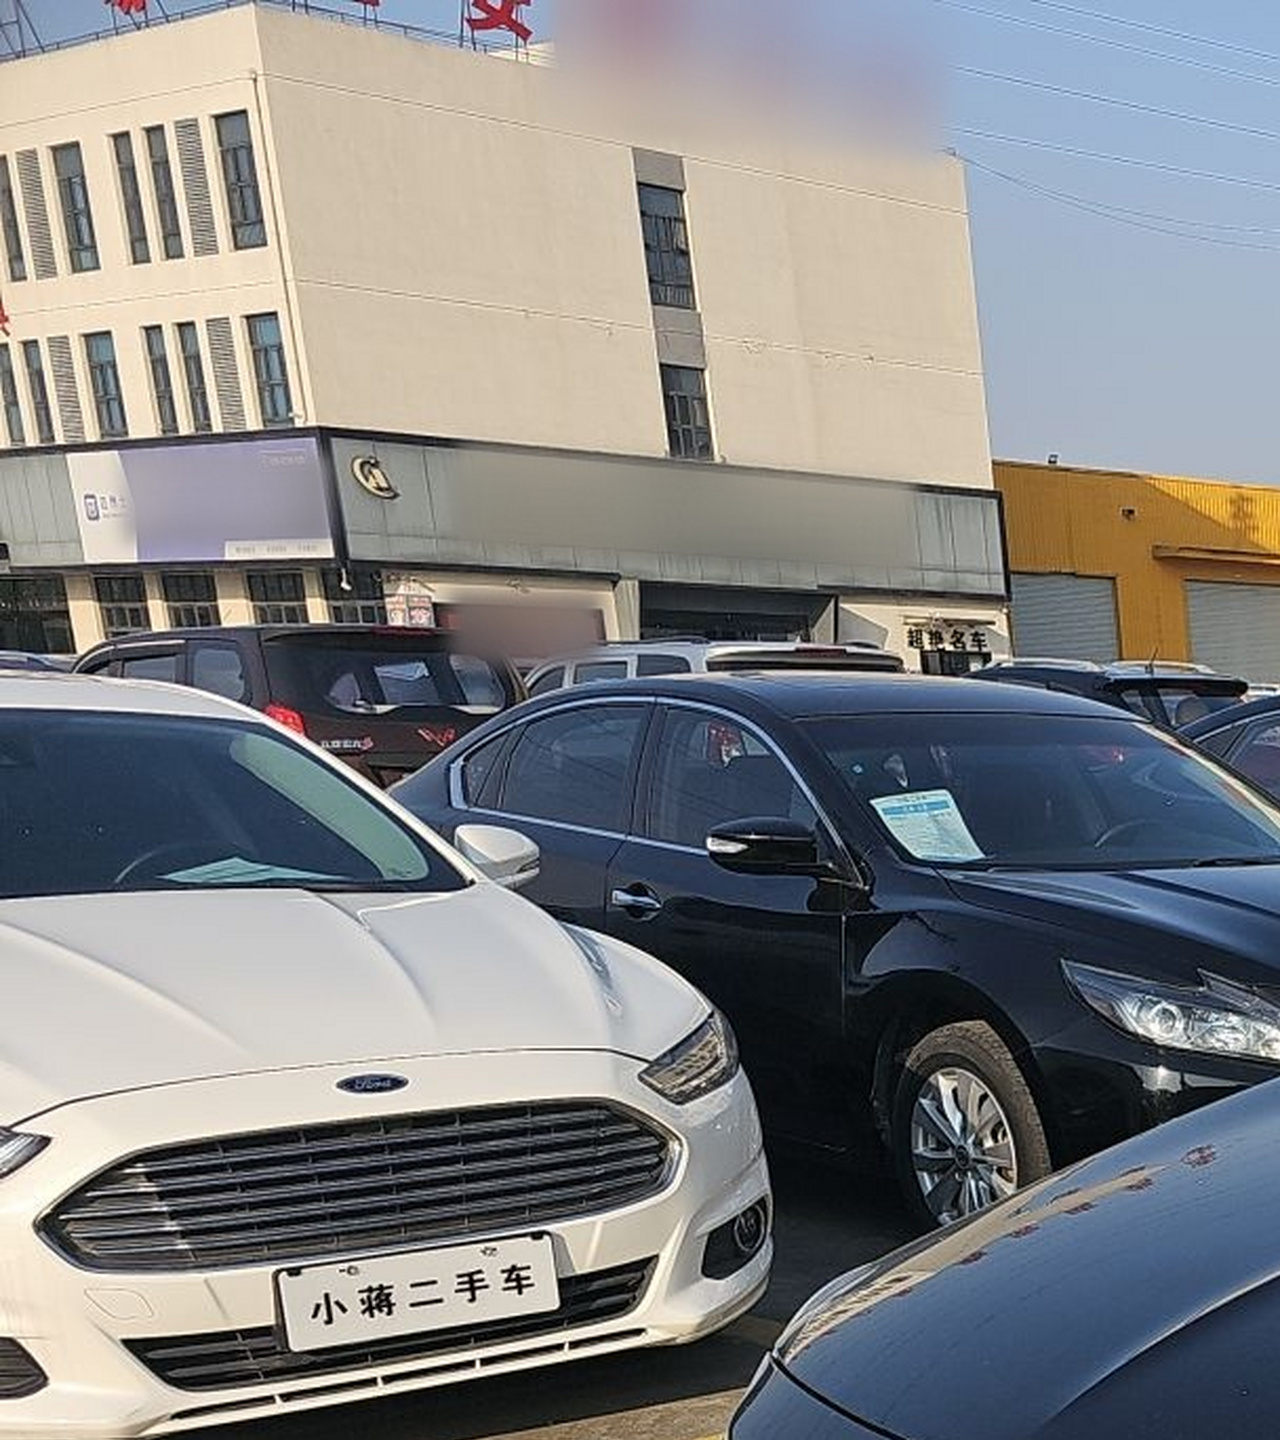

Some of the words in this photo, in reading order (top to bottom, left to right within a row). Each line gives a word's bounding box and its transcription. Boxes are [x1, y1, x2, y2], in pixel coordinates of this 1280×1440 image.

[311, 1263, 536, 1326] 小蒋二手车
